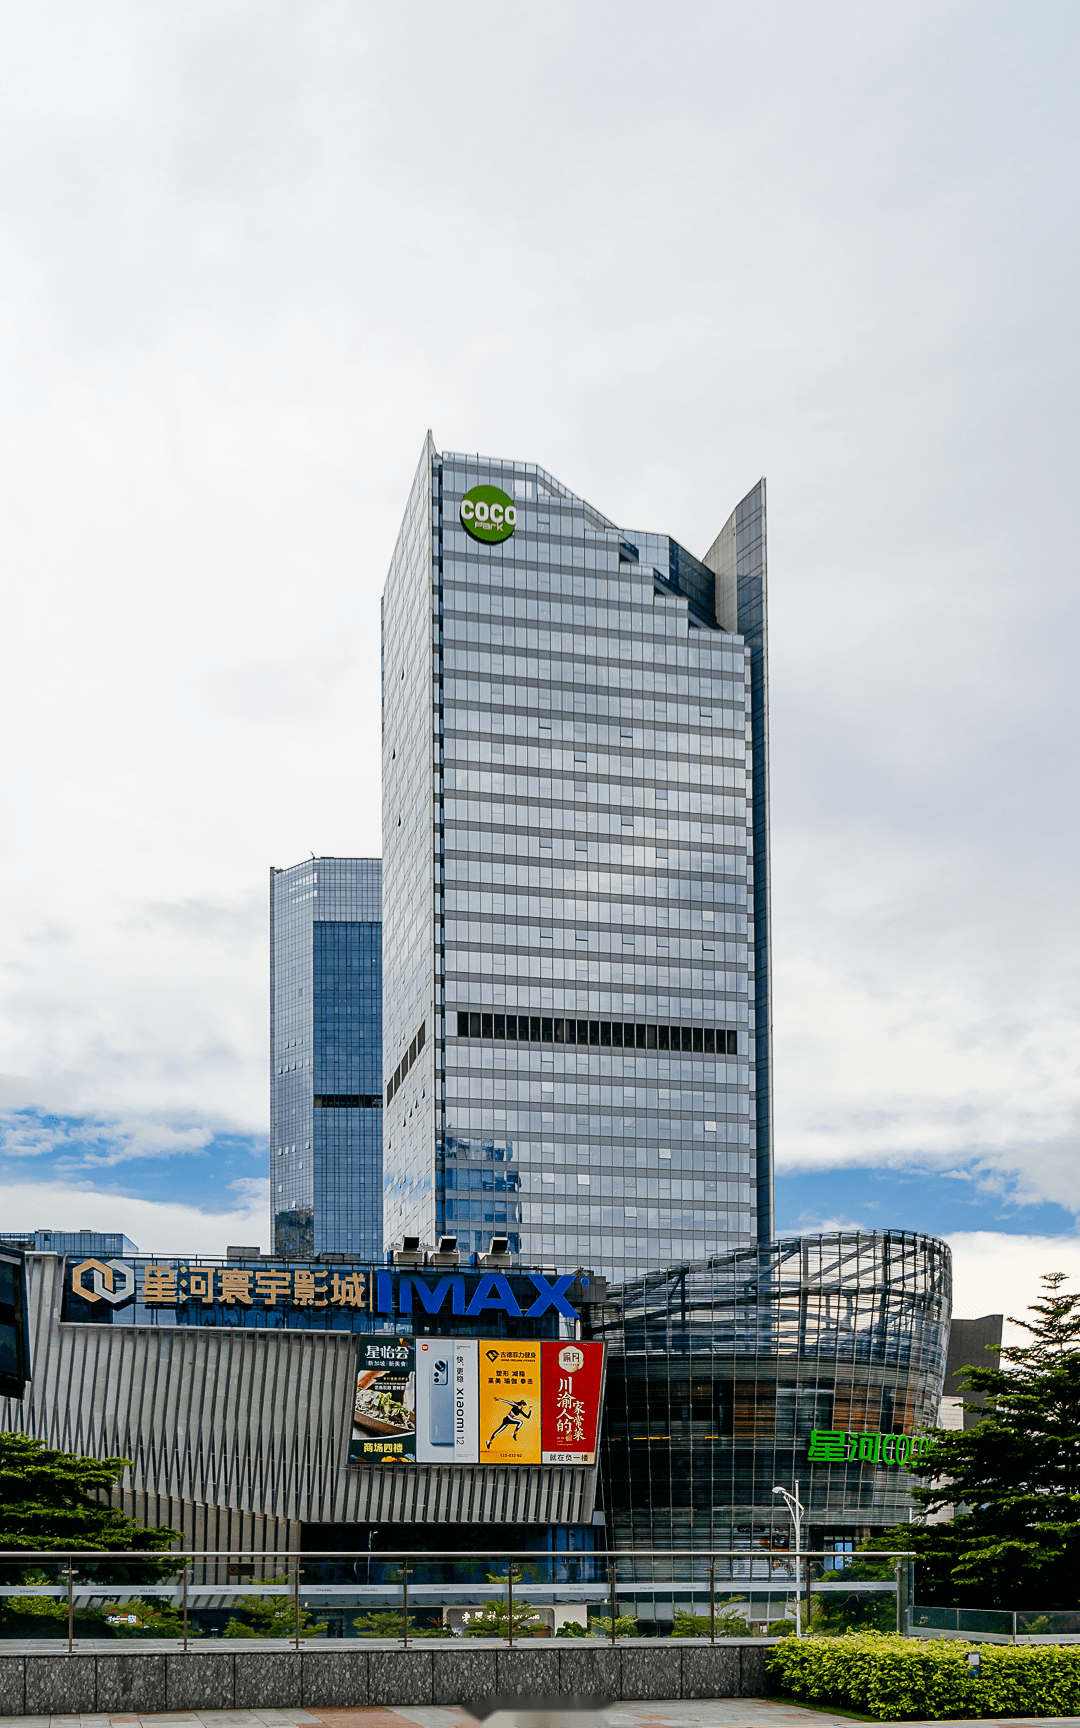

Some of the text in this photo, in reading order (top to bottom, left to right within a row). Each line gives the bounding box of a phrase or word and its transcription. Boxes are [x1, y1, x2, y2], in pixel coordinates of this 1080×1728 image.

[460, 499, 518, 526] COCO
[141, 1265, 581, 1319] 星河寰宇影城 IMAX
[364, 1345, 410, 1360] 星怡会
[556, 1375, 577, 1435] 川渝人的
[573, 1400, 587, 1442] 家常菜
[363, 1442, 404, 1454] 商场四楼
[456, 1436, 465, 1446] 12
